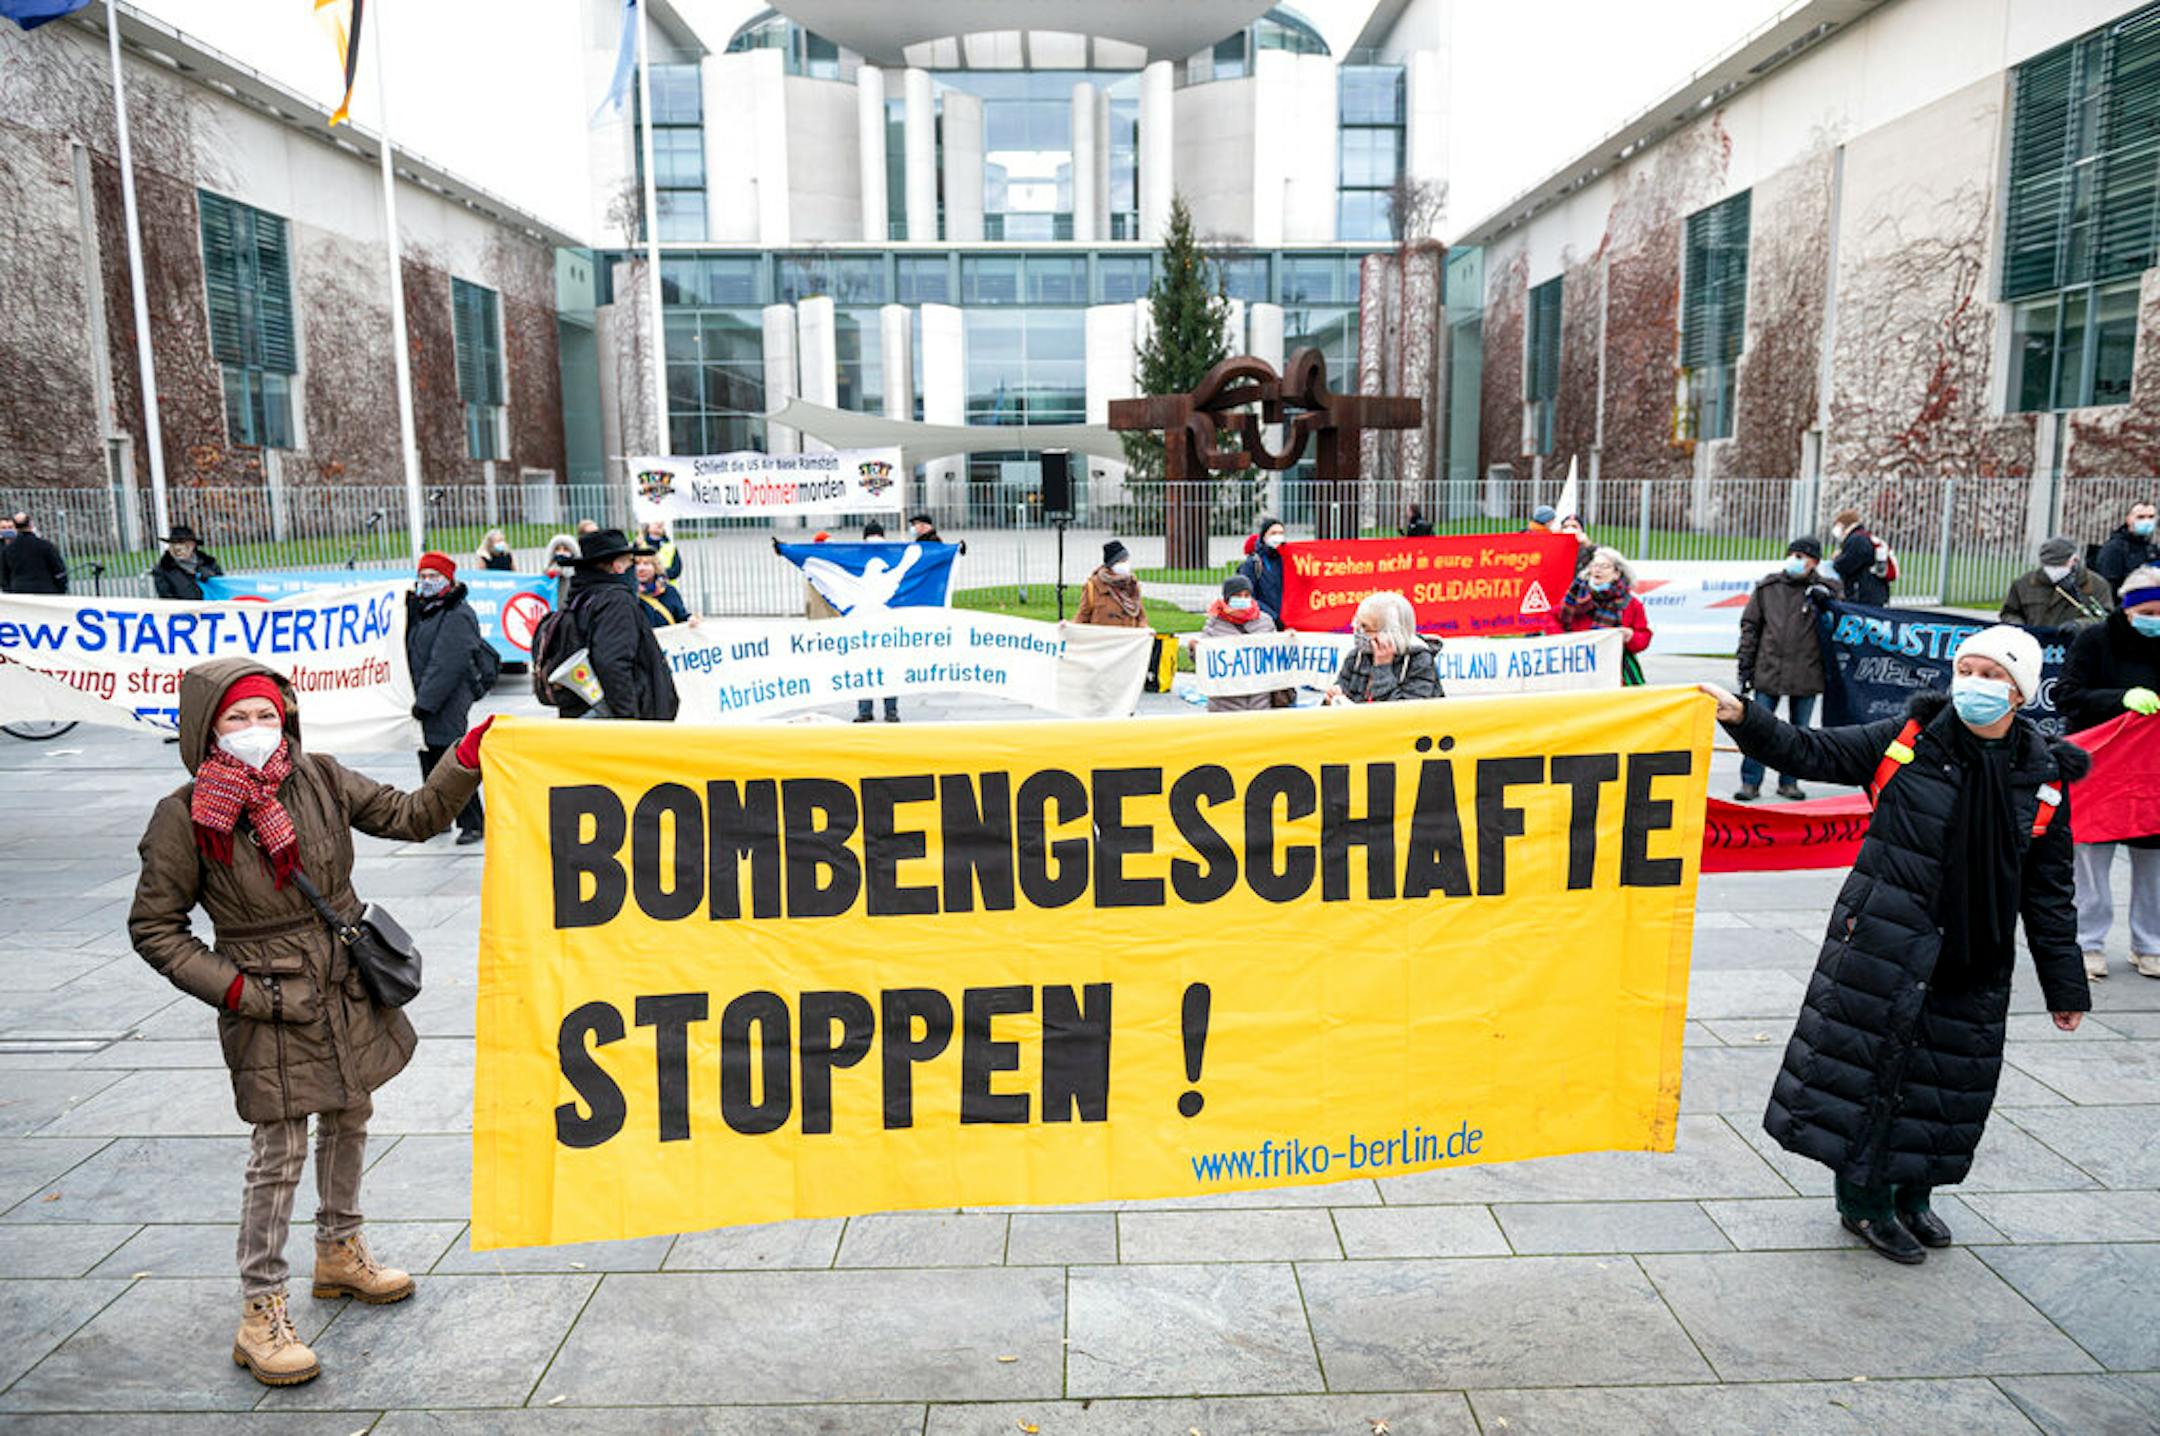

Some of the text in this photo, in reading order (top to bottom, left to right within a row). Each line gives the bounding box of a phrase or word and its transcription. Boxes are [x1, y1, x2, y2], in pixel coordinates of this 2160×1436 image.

[747, 459, 759, 470] US
[799, 456, 839, 471] Ramstein
[692, 479, 721, 503] Nein
[724, 484, 740, 505] zu
[743, 474, 847, 506] Drohnenmorden
[1292, 548, 1542, 577] Wir ziehen nicht in eure Kriege
[75, 590, 395, 656] START-VERTRAG
[289, 656, 391, 692] Atomwaffen
[662, 626, 1066, 674] riege und Kriegstreiberei beenden!
[1206, 642, 1339, 679] US-ATOMWAFFEN
[1508, 643, 1597, 679] ABZIEHEN
[719, 662, 1008, 712] Abrüsten statt aufrüsten
[549, 735, 1693, 930] BOMBENGESCHÄFTE
[554, 982, 1211, 1149] STOPPEN !
[1191, 1119, 1485, 1184] www.friko-berlin.de
